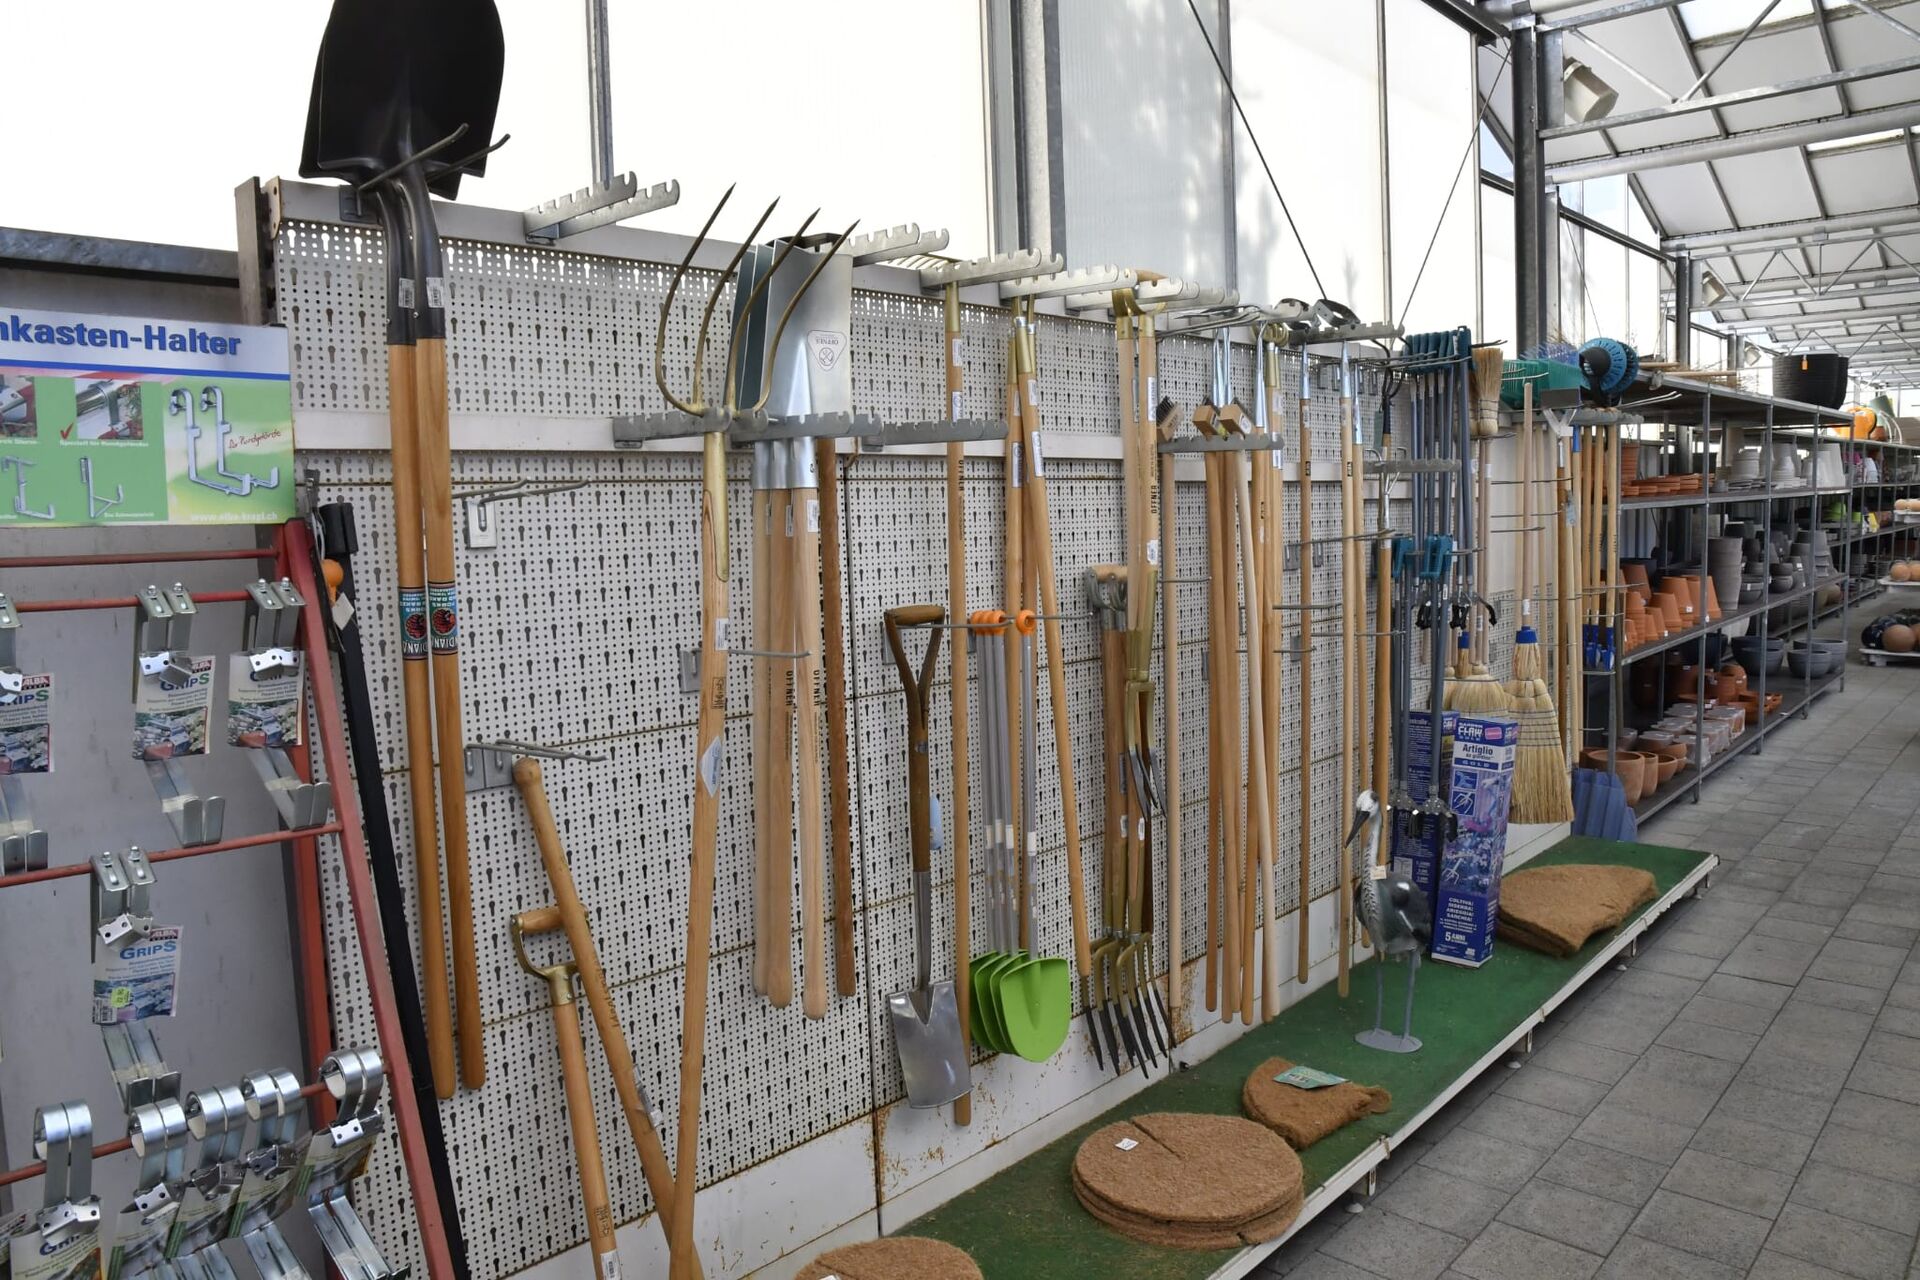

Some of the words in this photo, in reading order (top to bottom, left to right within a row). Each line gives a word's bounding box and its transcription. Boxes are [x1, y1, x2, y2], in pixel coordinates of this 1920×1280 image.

[1150, 485, 1158, 514] OFFNER
[785, 670, 794, 707] OFFNER
[812, 669, 821, 706] OFFNER
[1463, 743, 1494, 756] Artiglio
[1445, 931, 1452, 941] 5
[119, 941, 177, 959] GRIPS
